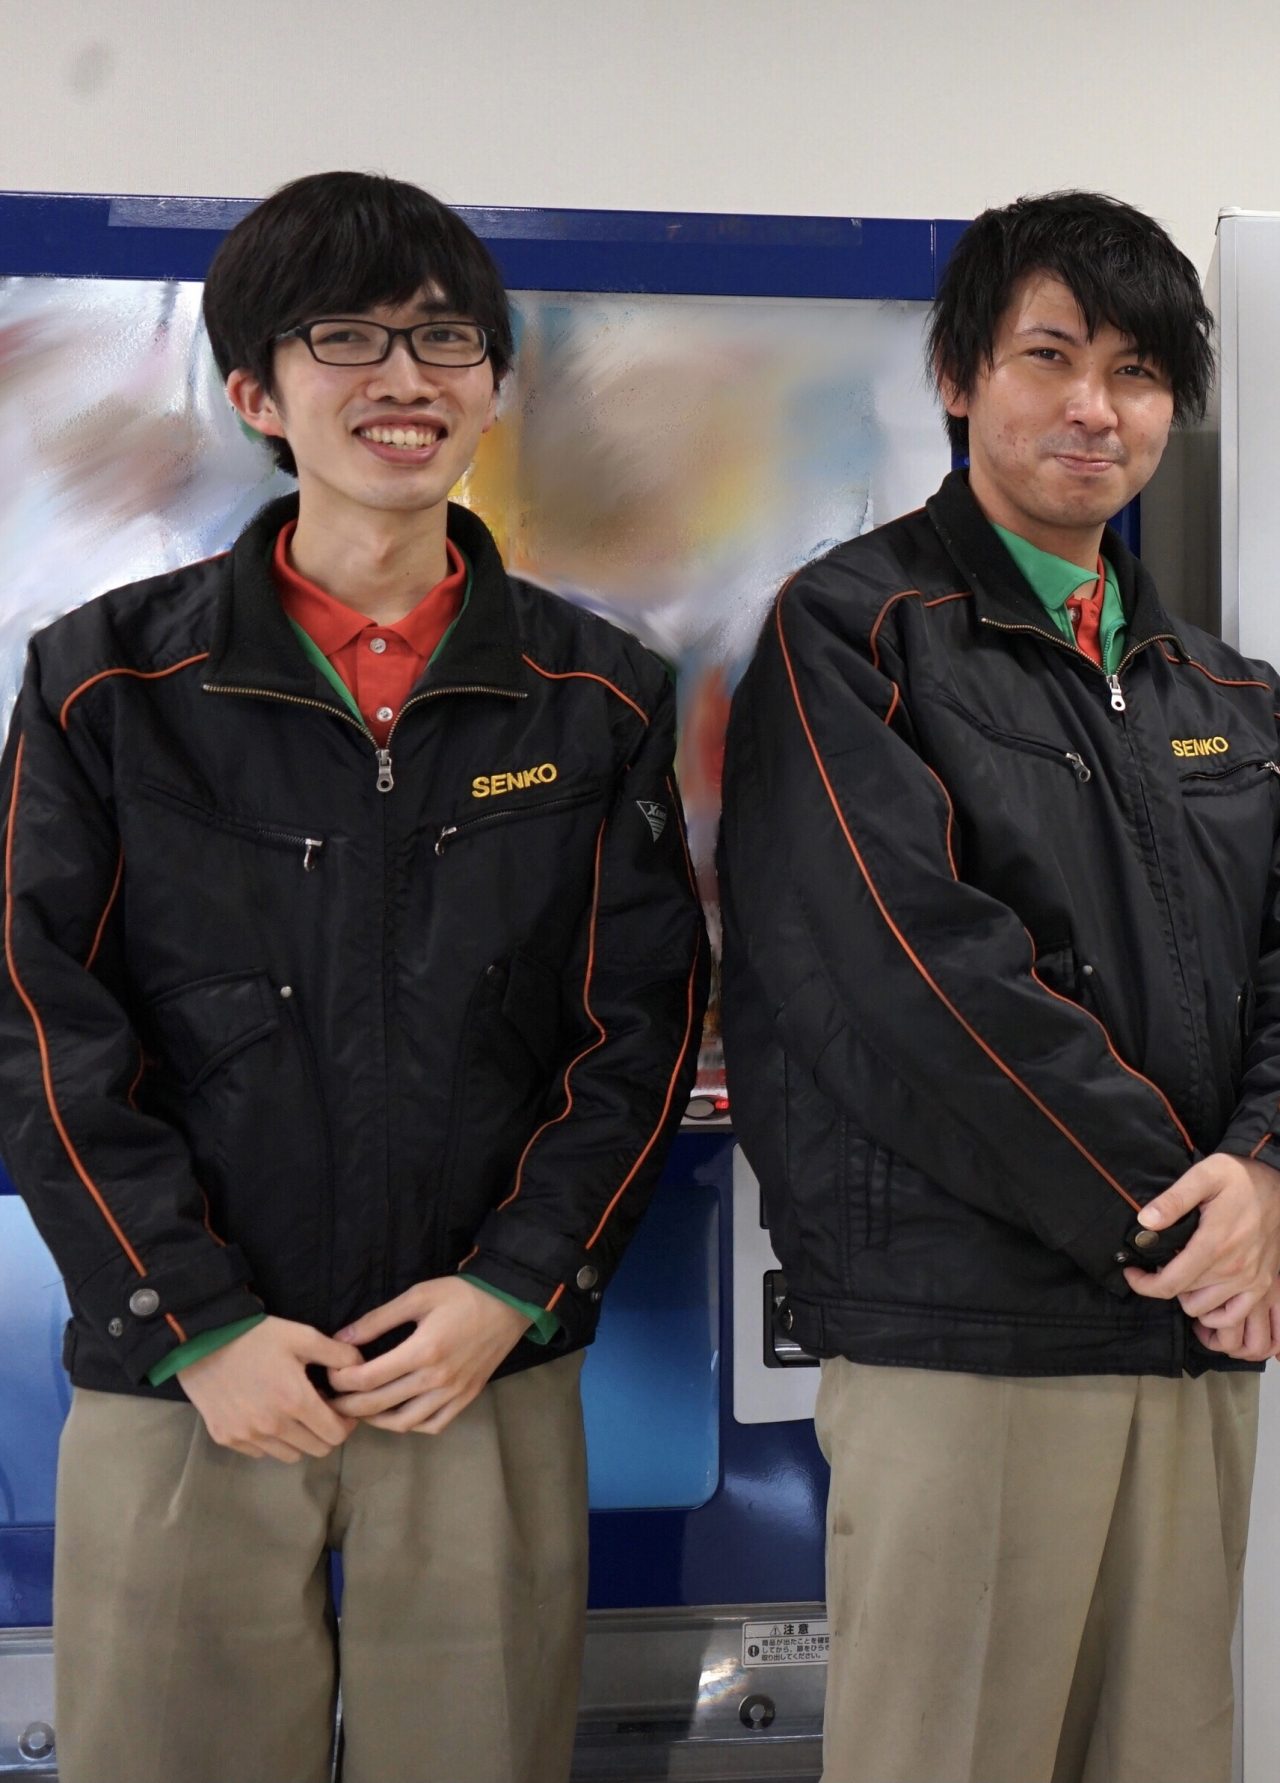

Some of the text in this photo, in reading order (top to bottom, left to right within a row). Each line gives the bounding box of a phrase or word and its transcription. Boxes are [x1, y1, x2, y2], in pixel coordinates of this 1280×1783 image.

[1171, 736, 1229, 758] SENKO
[472, 763, 557, 798] SENKO
[783, 1623, 809, 1635] 注意
